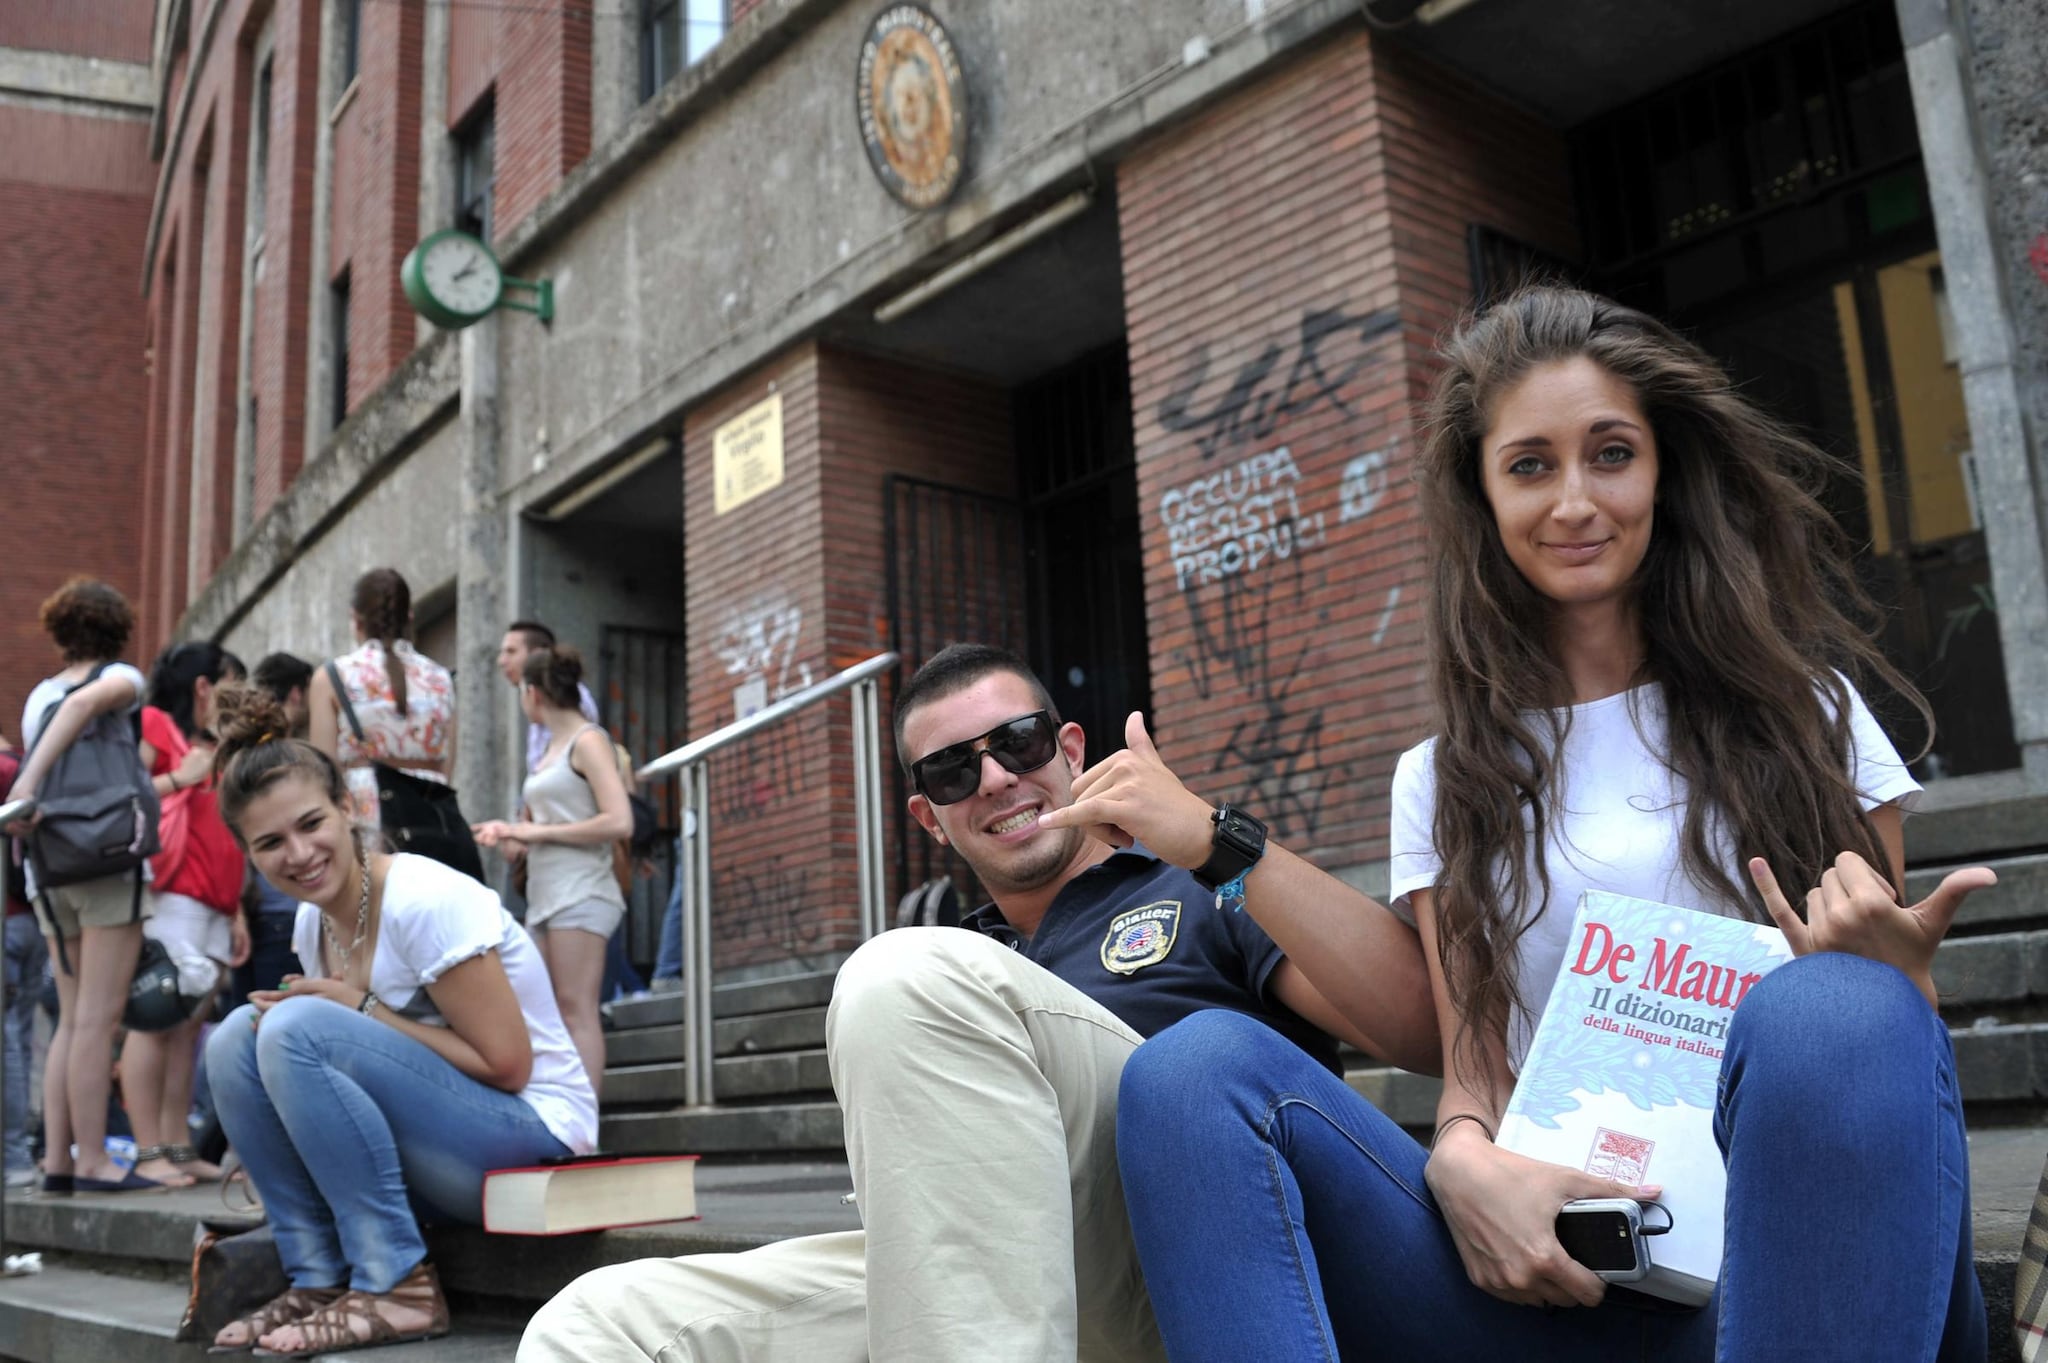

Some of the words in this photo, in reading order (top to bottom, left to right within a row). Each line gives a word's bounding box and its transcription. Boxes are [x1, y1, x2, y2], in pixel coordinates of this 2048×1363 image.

[1159, 446, 1301, 527] OCCUPA
[1570, 922, 1635, 983] De
[1638, 937, 1761, 1011] Maur
[1583, 1013, 1620, 1034] della
[1623, 1022, 1673, 1046] lingua
[1675, 1035, 1724, 1061] italian
[1588, 986, 1612, 1012] Il
[1615, 993, 1728, 1040] dizionari
